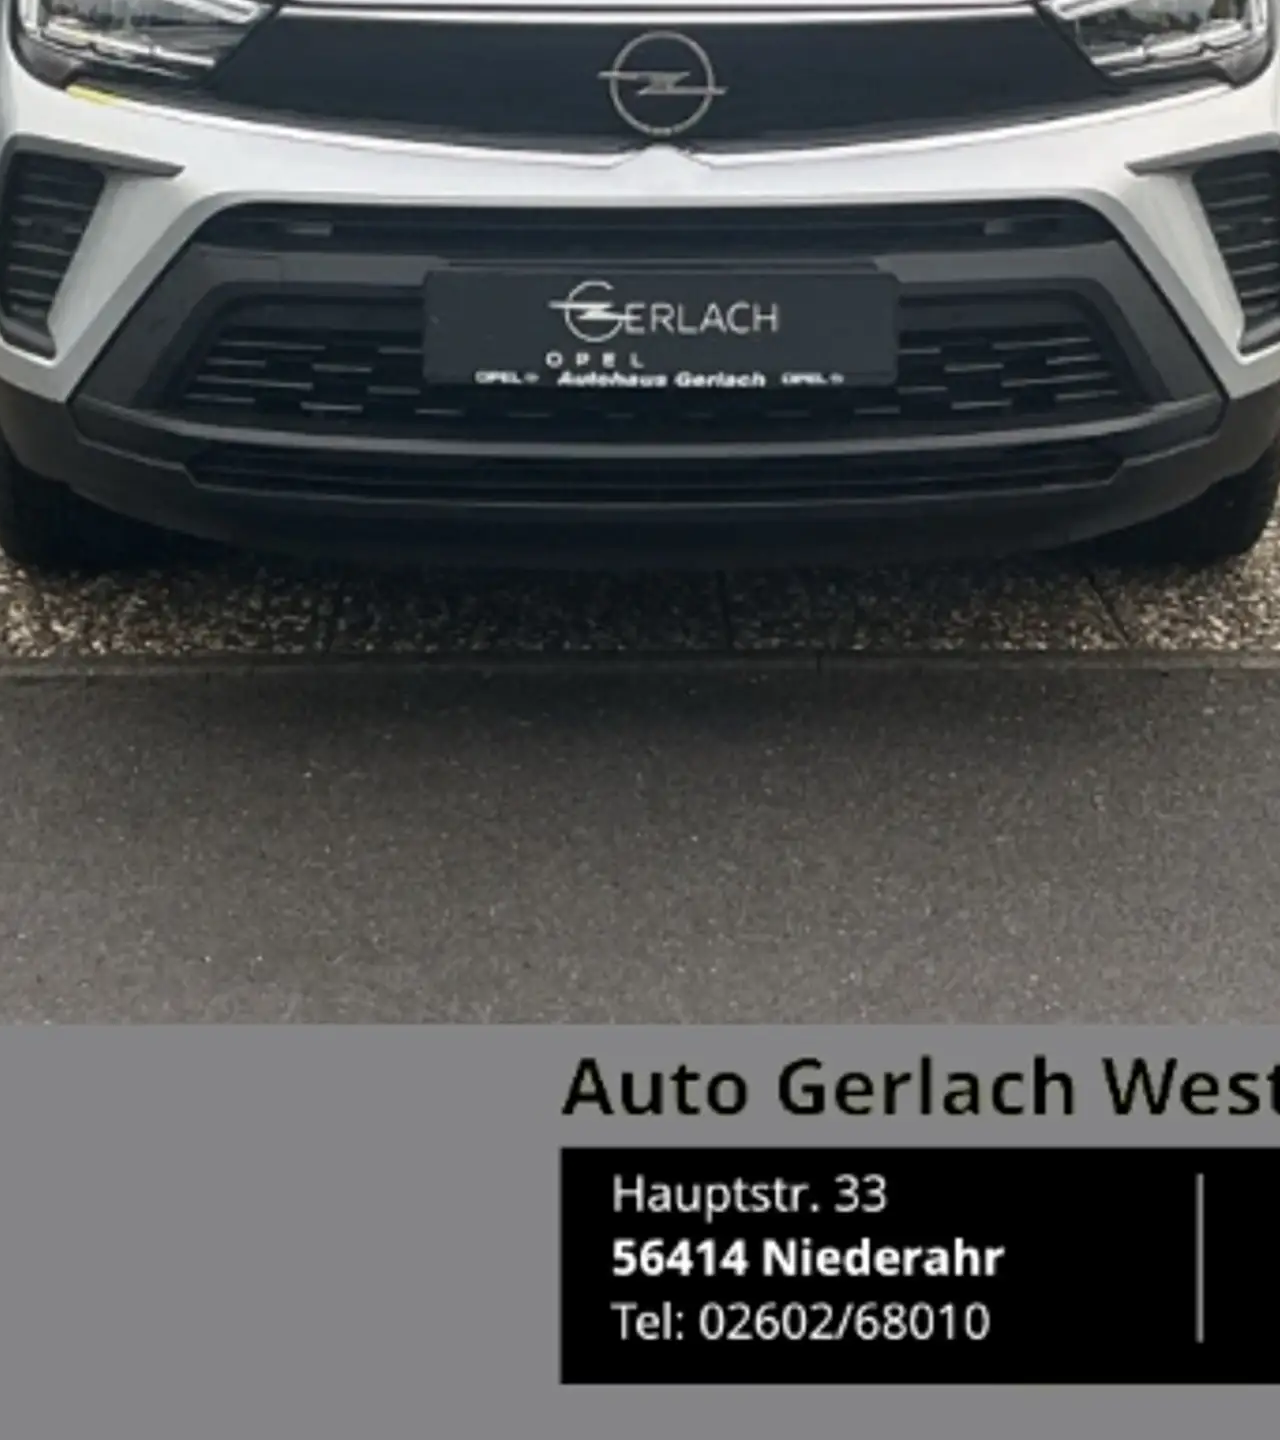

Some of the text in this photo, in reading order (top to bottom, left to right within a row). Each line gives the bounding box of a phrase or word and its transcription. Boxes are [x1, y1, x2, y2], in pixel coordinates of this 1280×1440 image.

[545, 351, 645, 369] OPEL
[557, 371, 767, 388] Autohaus Gerlach
